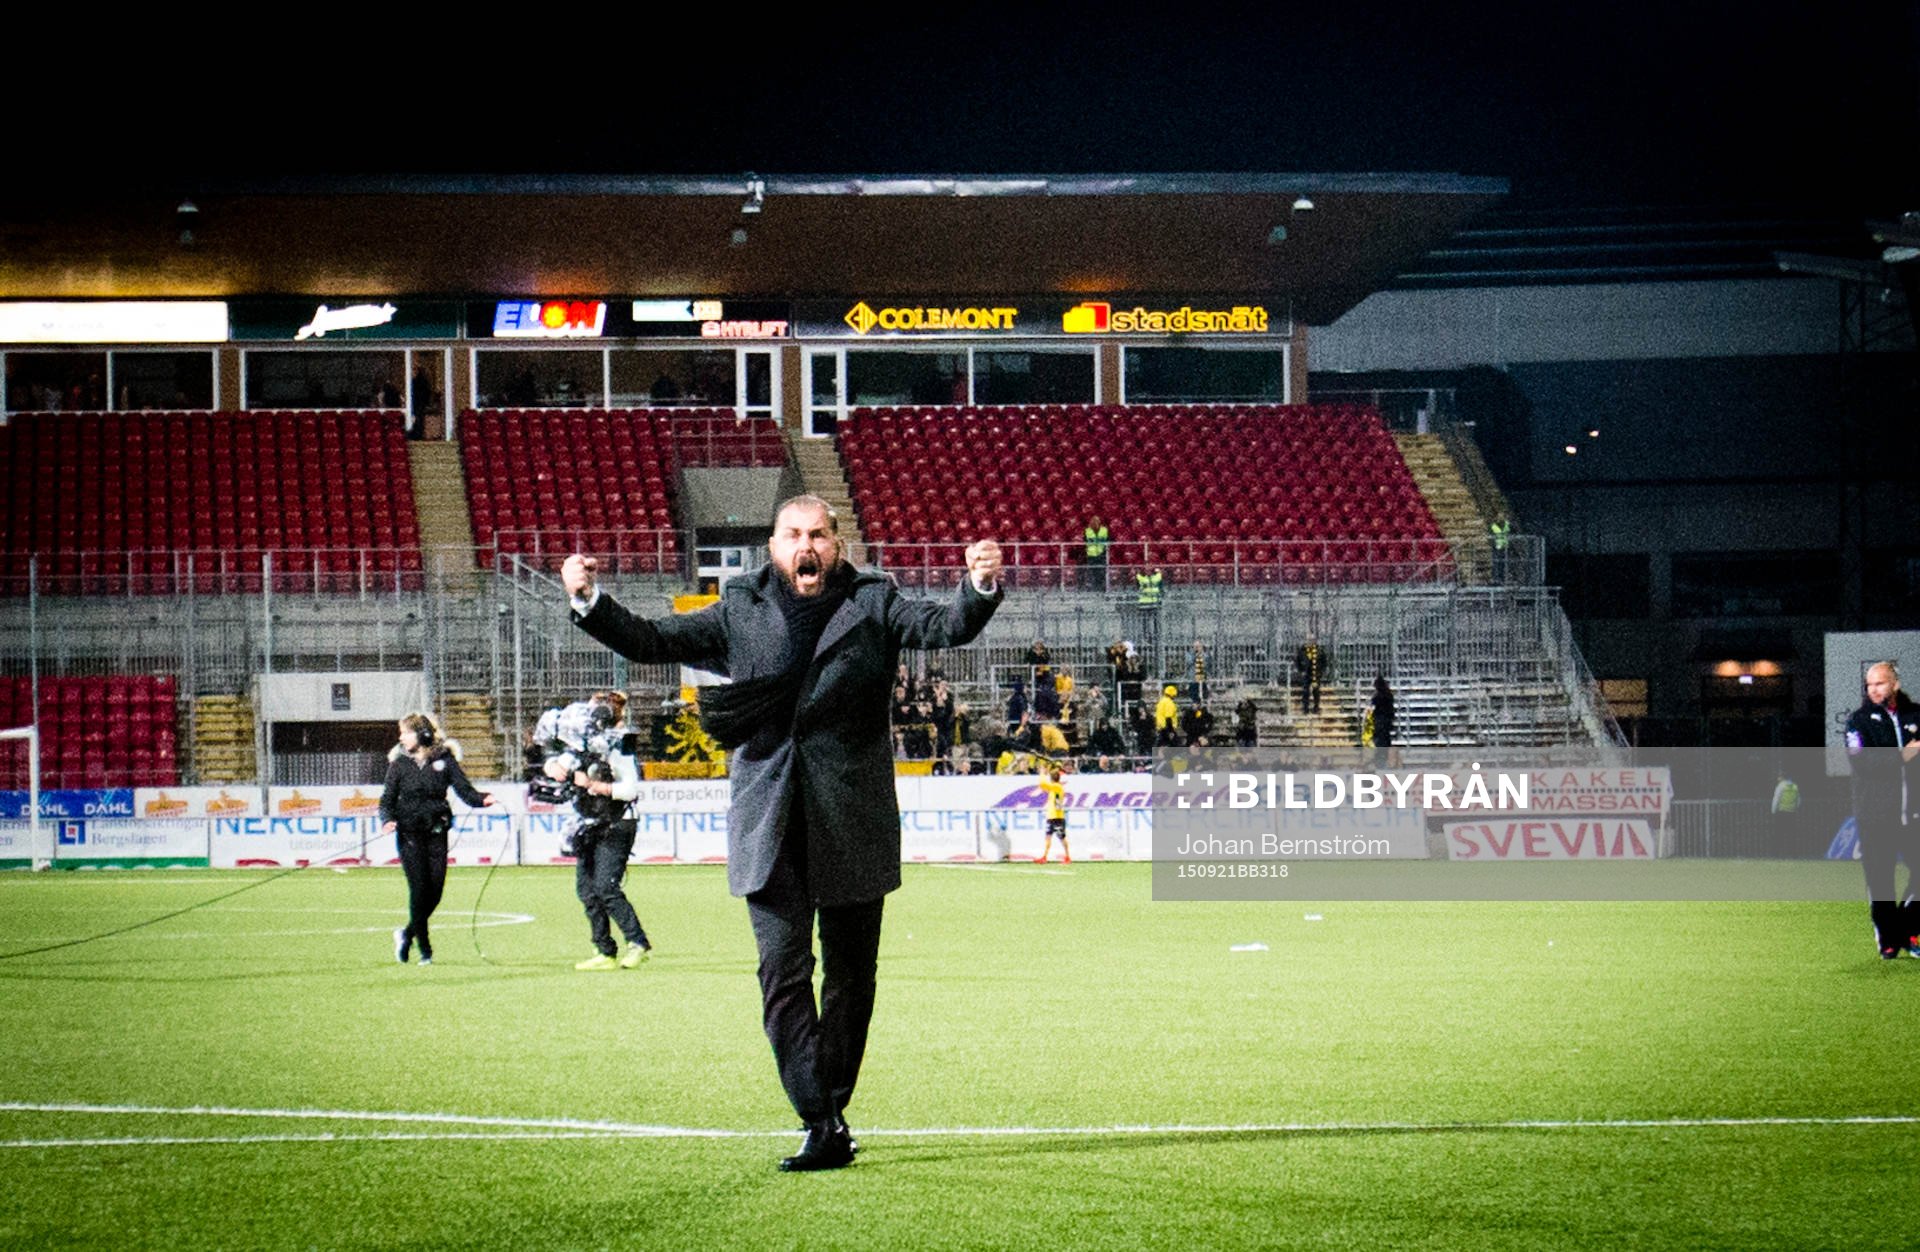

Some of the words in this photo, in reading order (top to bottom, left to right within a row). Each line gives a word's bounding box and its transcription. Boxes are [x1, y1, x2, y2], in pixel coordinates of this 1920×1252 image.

[879, 307, 1017, 329] COLEMONT
[1112, 306, 1267, 332] stadsnät
[1531, 770, 1662, 787] KAKEL
[651, 785, 729, 803] förpackni
[84, 802, 131, 816] DAHL
[1452, 822, 1650, 858] SVEVIA
